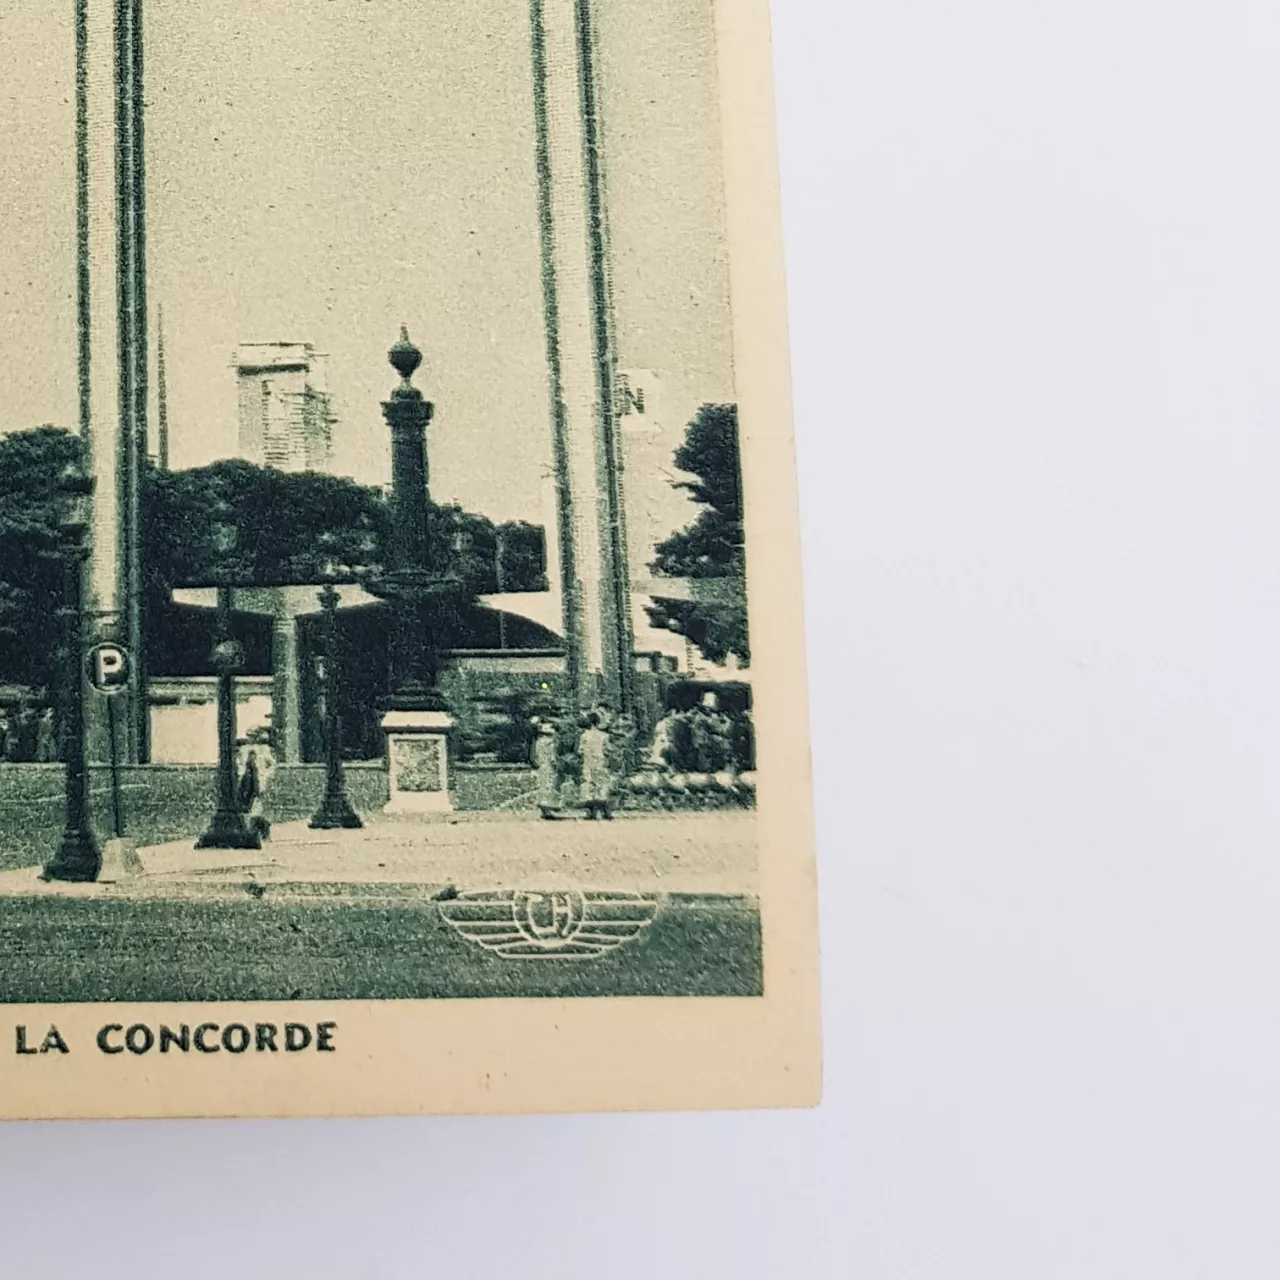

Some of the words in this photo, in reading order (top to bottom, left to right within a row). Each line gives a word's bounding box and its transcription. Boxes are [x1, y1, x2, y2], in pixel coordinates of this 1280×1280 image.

[96, 648, 122, 684] P
[15, 1024, 69, 1054] LA
[96, 1022, 338, 1054] CONCORDE
